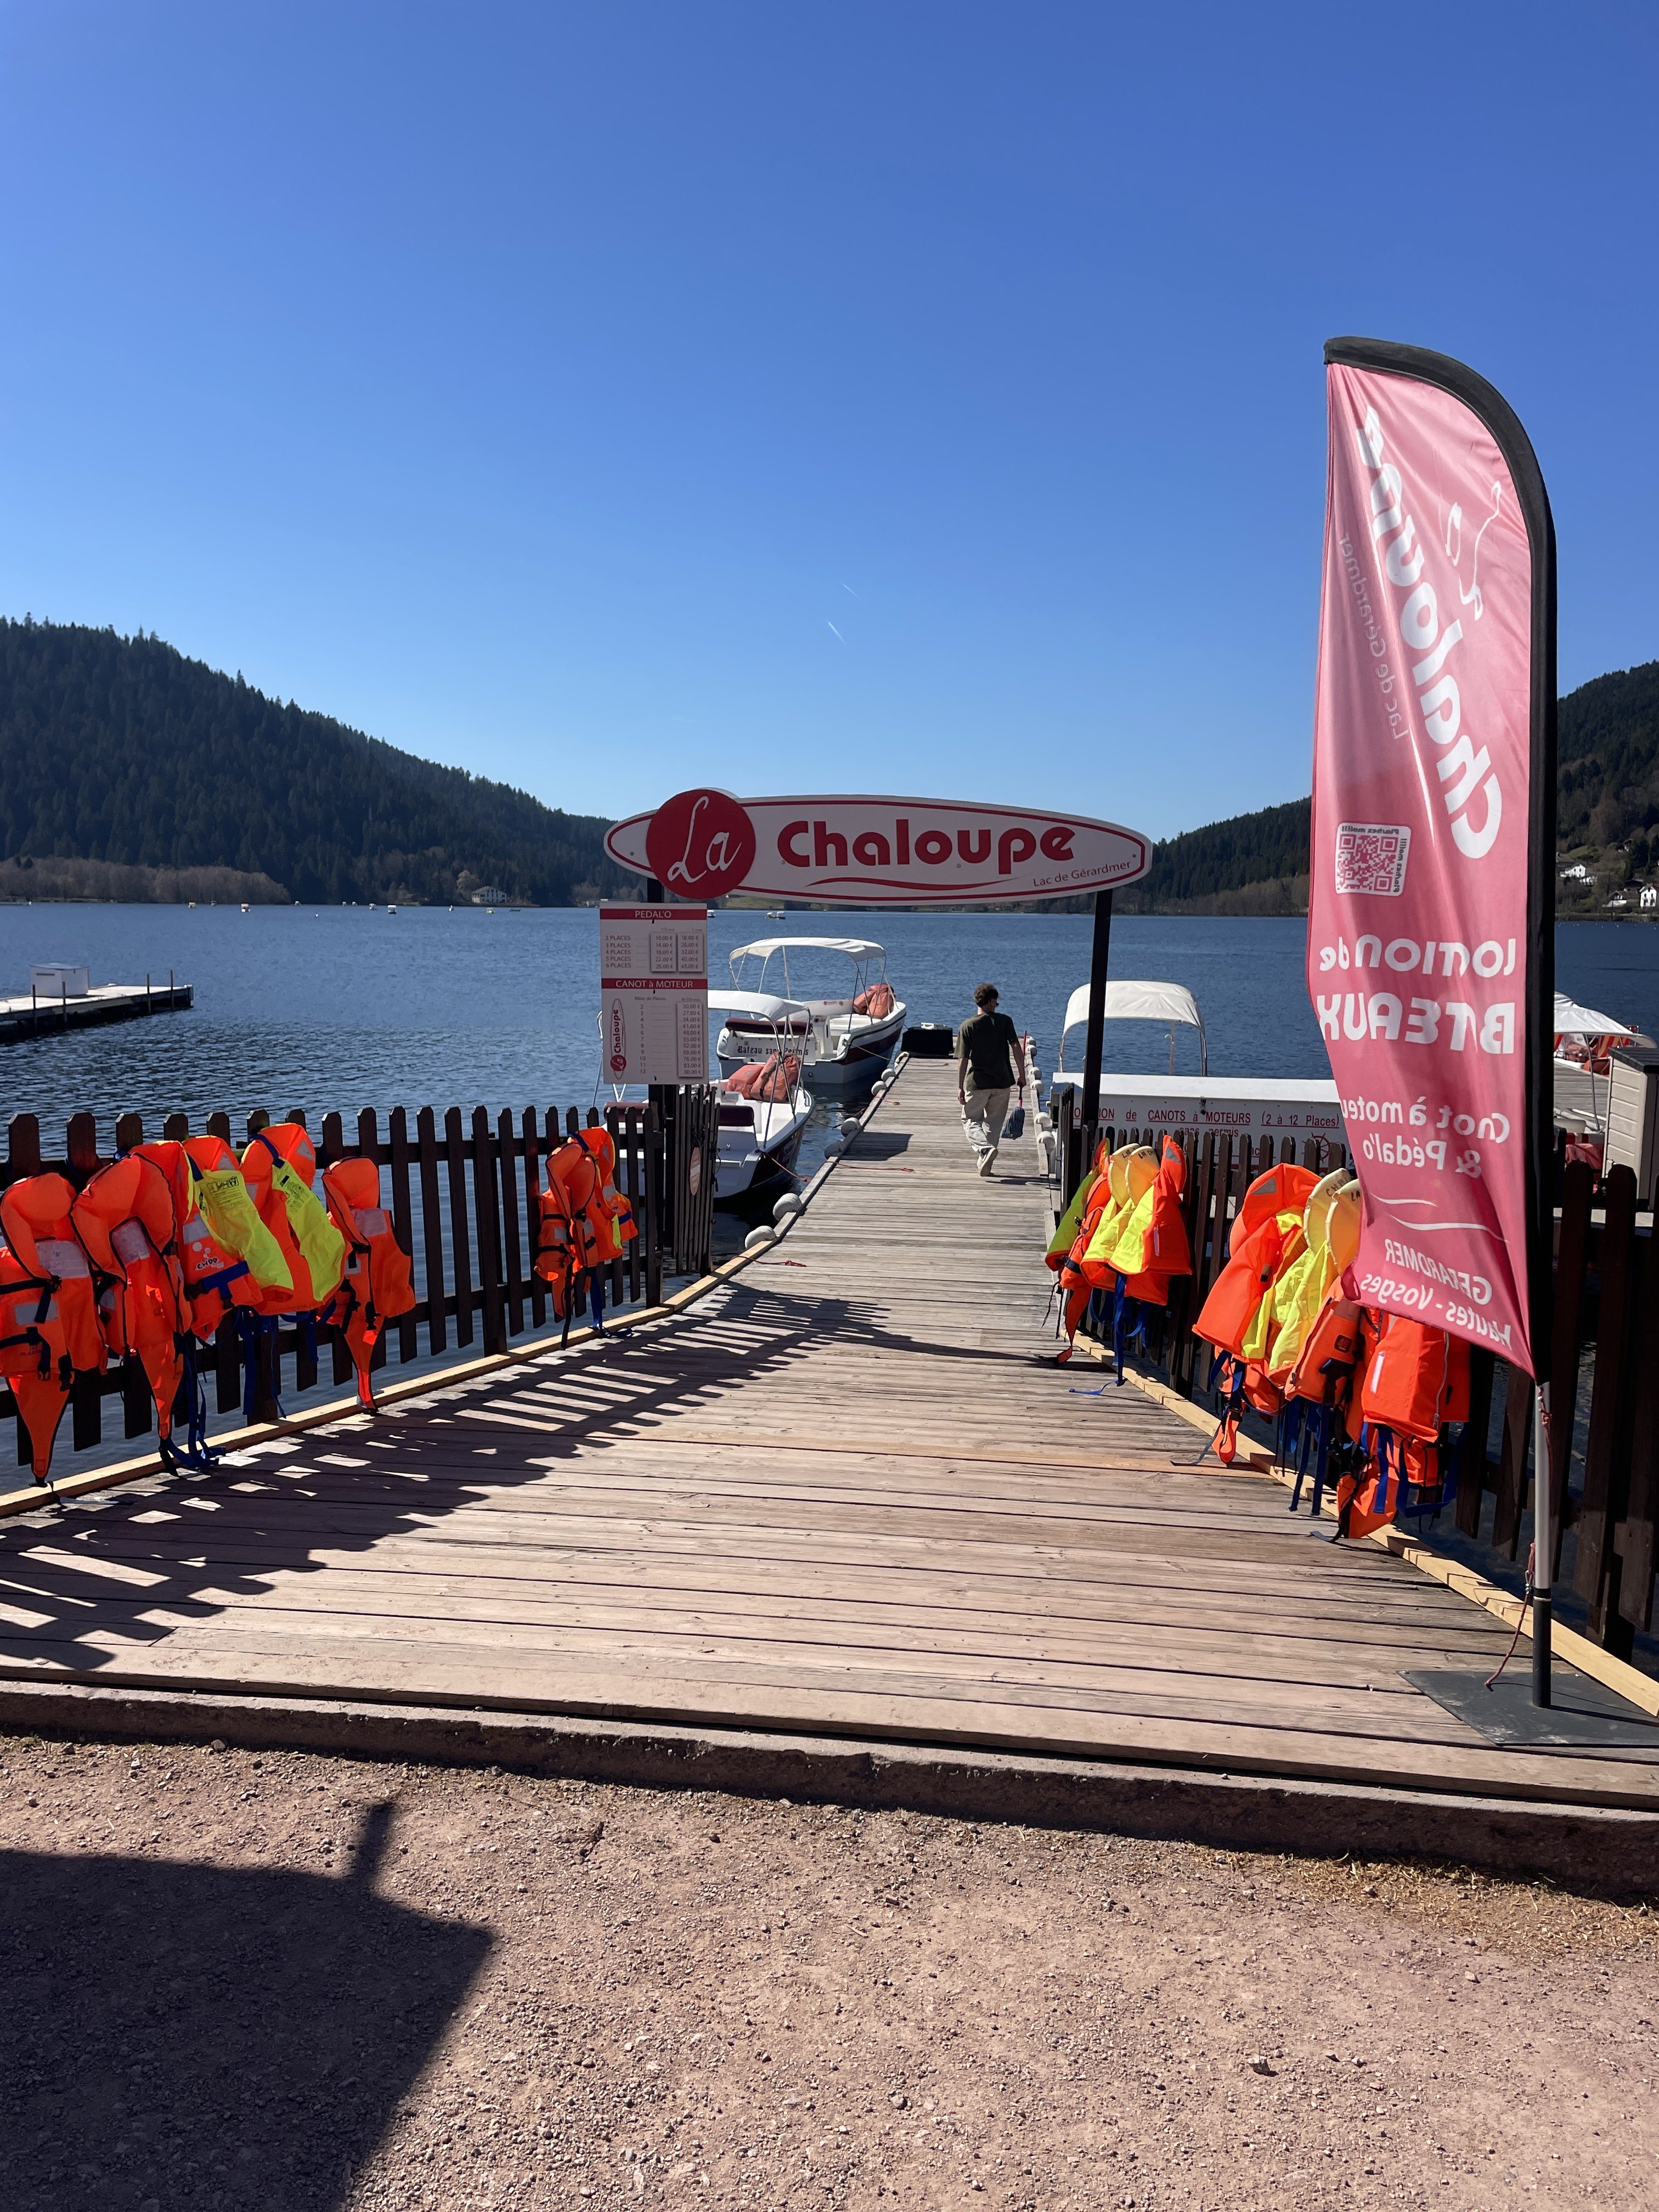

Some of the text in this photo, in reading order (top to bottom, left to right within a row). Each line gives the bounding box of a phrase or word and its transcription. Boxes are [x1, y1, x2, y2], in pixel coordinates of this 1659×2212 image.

[667, 795, 1075, 883] La Chaloupe
[1033, 861, 1131, 887] Lac de Gérardmer
[635, 910, 672, 918] PEDAL'O
[1126, 1109, 1137, 1120] de
[1147, 1109, 1186, 1121] CANOTS
[1193, 1111, 1198, 1122] à
[1206, 1111, 1251, 1124] MOTEURS
[1261, 1110, 1272, 1125] (2
[1277, 1114, 1283, 1125] à
[1289, 1115, 1299, 1125] 12
[1306, 1113, 1340, 1127] Places)
